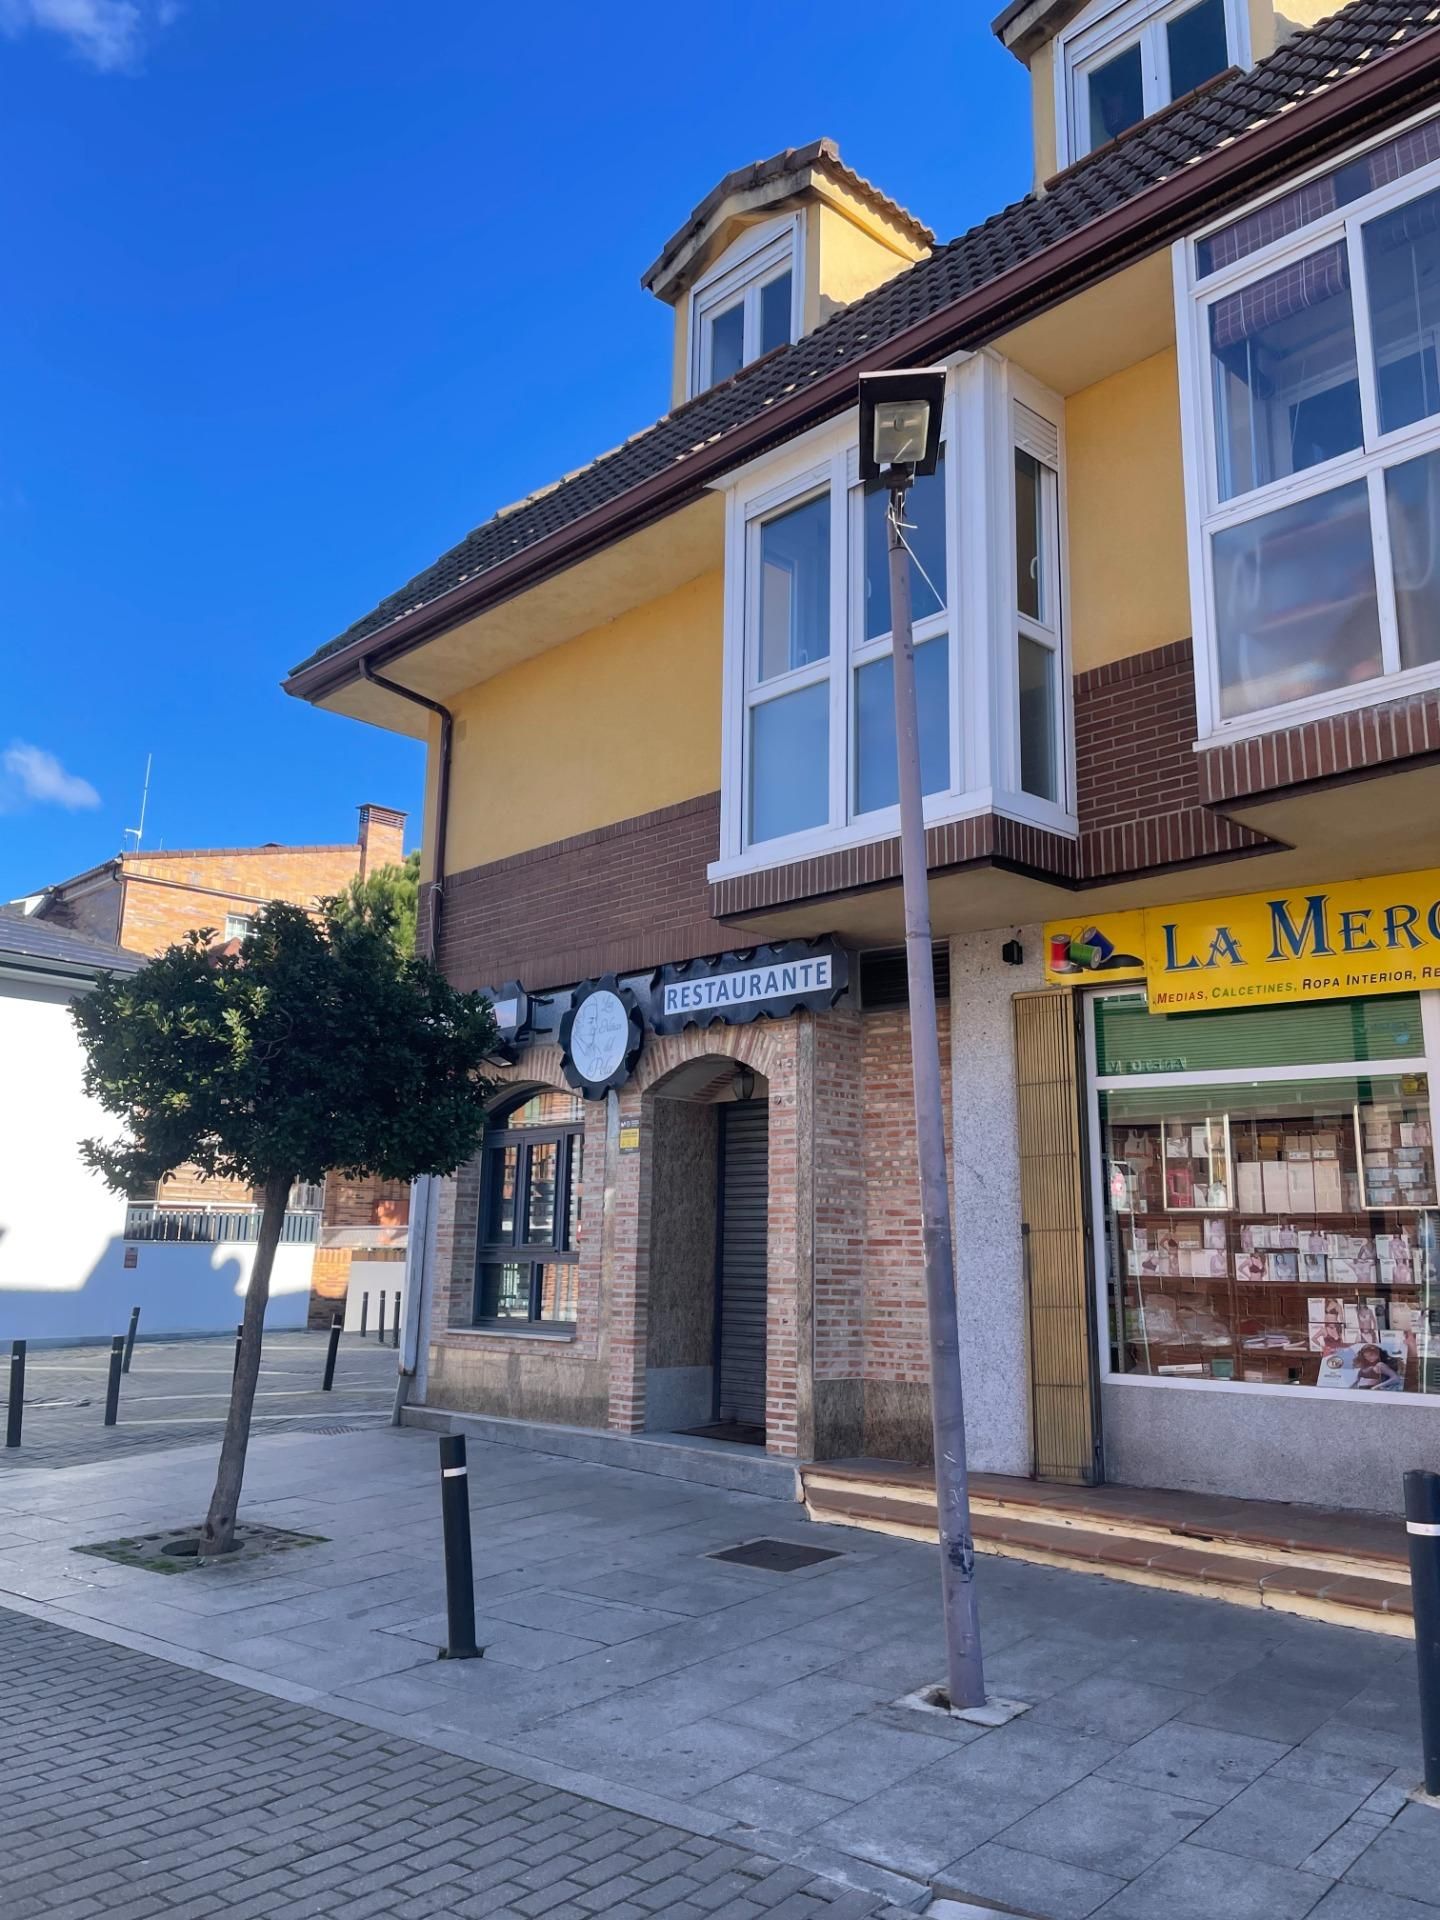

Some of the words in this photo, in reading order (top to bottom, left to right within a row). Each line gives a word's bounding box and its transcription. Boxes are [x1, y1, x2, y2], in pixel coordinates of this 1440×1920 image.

[1161, 924, 1248, 973] LA
[666, 961, 828, 1010] RESTAURANTE
[1156, 990, 1208, 1005] MEDIAS,
[1211, 982, 1298, 999] CALCETINES,
[1302, 977, 1340, 991] ROPA
[1346, 970, 1417, 986] INTERIOR,
